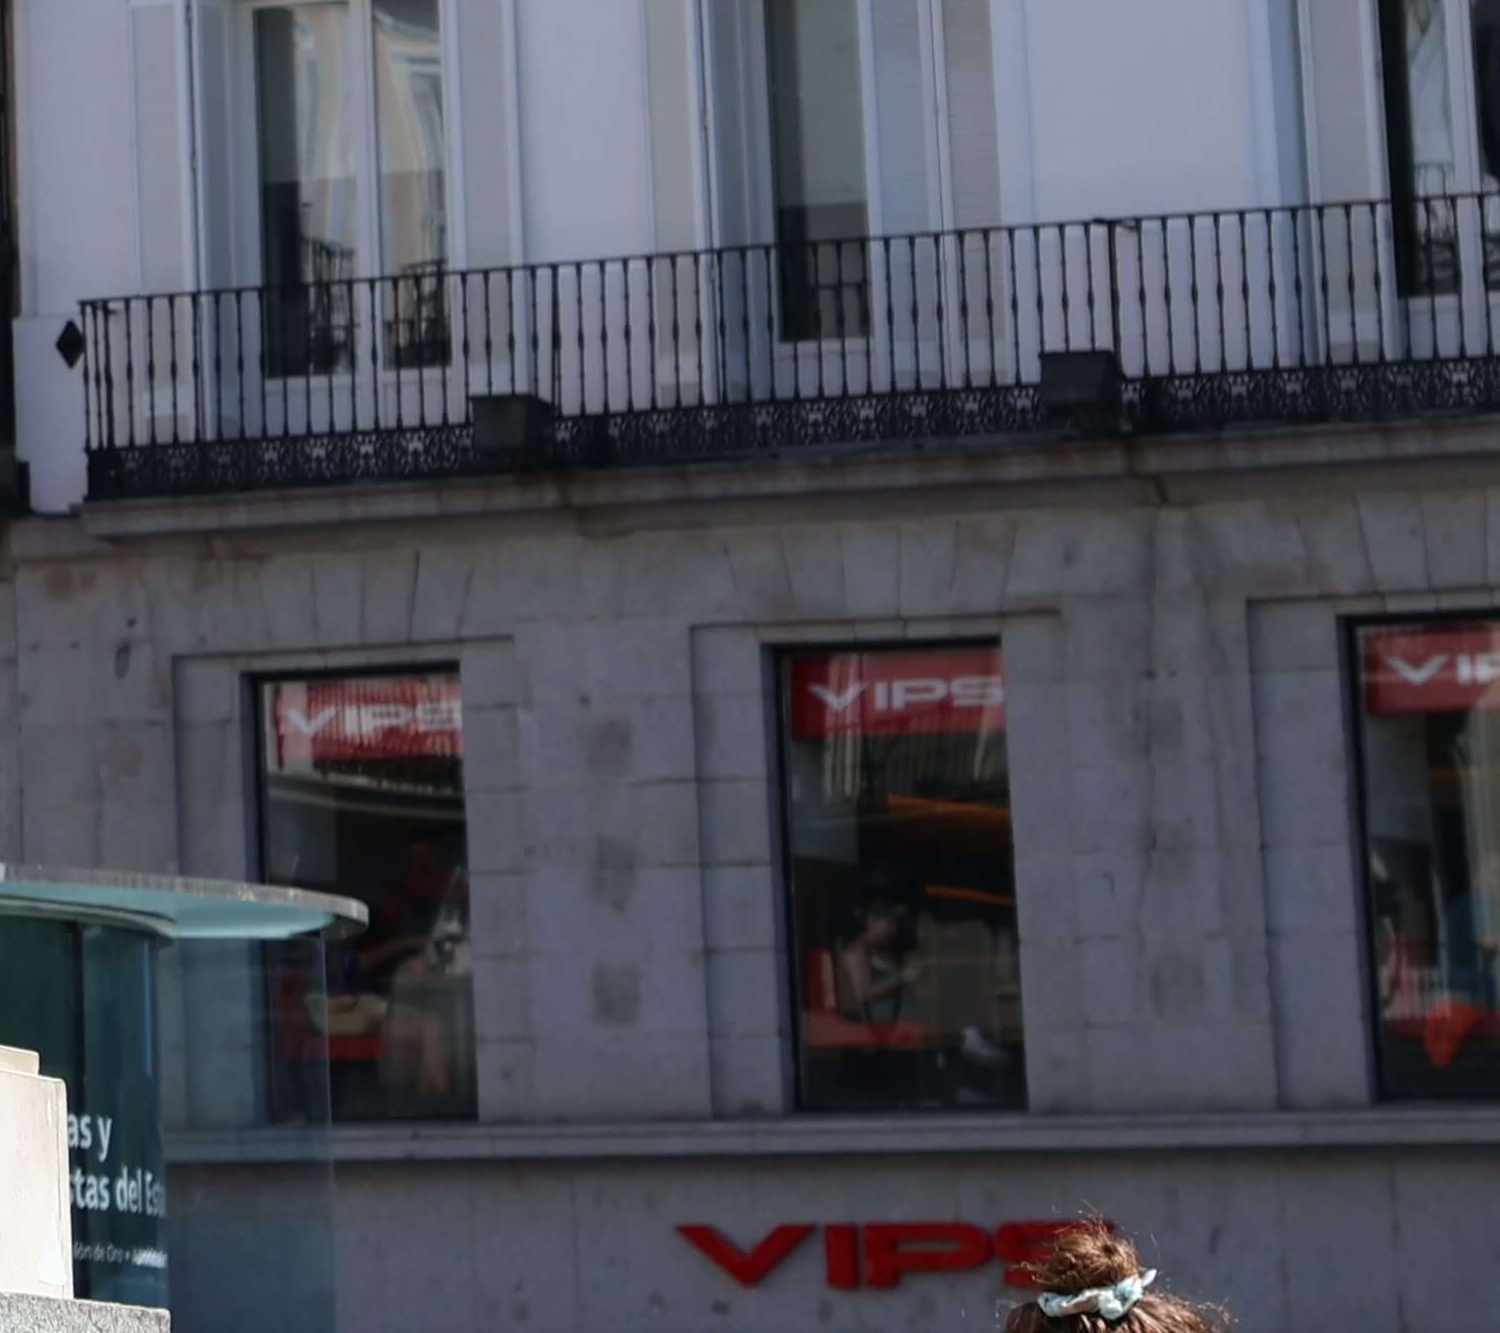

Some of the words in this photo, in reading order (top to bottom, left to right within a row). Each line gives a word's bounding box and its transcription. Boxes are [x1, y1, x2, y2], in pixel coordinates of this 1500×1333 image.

[807, 675, 1005, 712] VIPS
[284, 700, 463, 737] VIPS
[97, 1116, 112, 1162] y
[69, 1167, 110, 1211] tas
[115, 1163, 143, 1214] del
